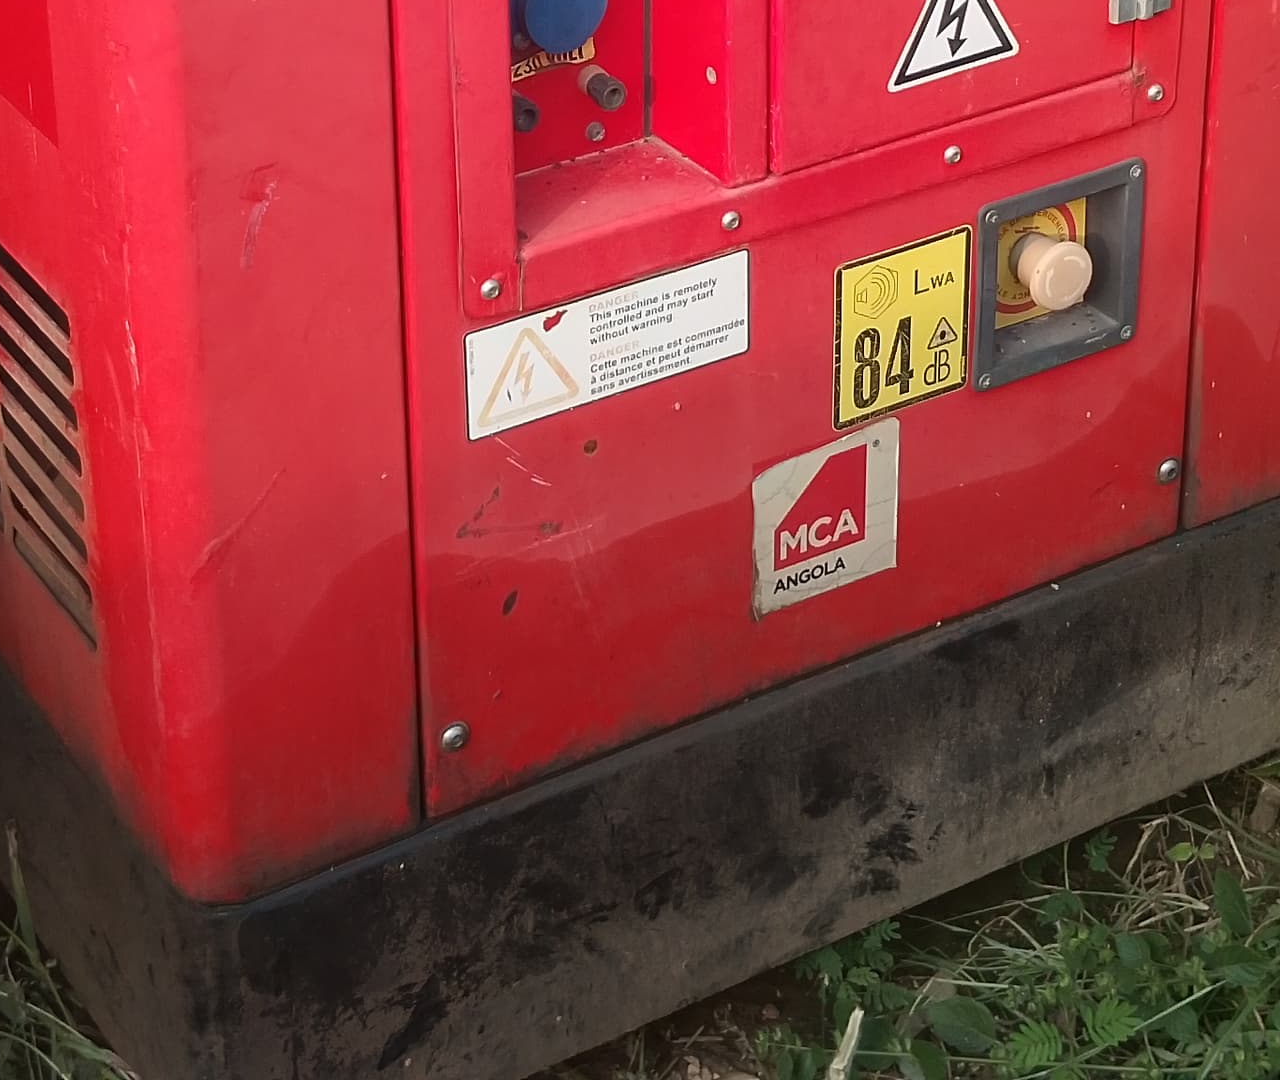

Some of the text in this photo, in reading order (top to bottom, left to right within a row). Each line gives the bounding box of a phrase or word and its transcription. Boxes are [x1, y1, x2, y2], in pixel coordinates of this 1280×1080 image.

[588, 290, 639, 313] DANGER
[590, 277, 718, 323] This machine is remotely
[590, 288, 714, 335] controlled and may start
[590, 313, 673, 345] without warning
[590, 318, 745, 374] Cette machine est commandée
[589, 340, 640, 363] DANGER
[600, 362, 643, 382] distance
[646, 357, 656, 368] et
[658, 350, 681, 368] peut
[852, 315, 914, 410] 84
[923, 349, 951, 386] dB
[590, 357, 691, 395] sans avertissement
[779, 508, 859, 561] MCA
[773, 556, 847, 595] ANGOLA
